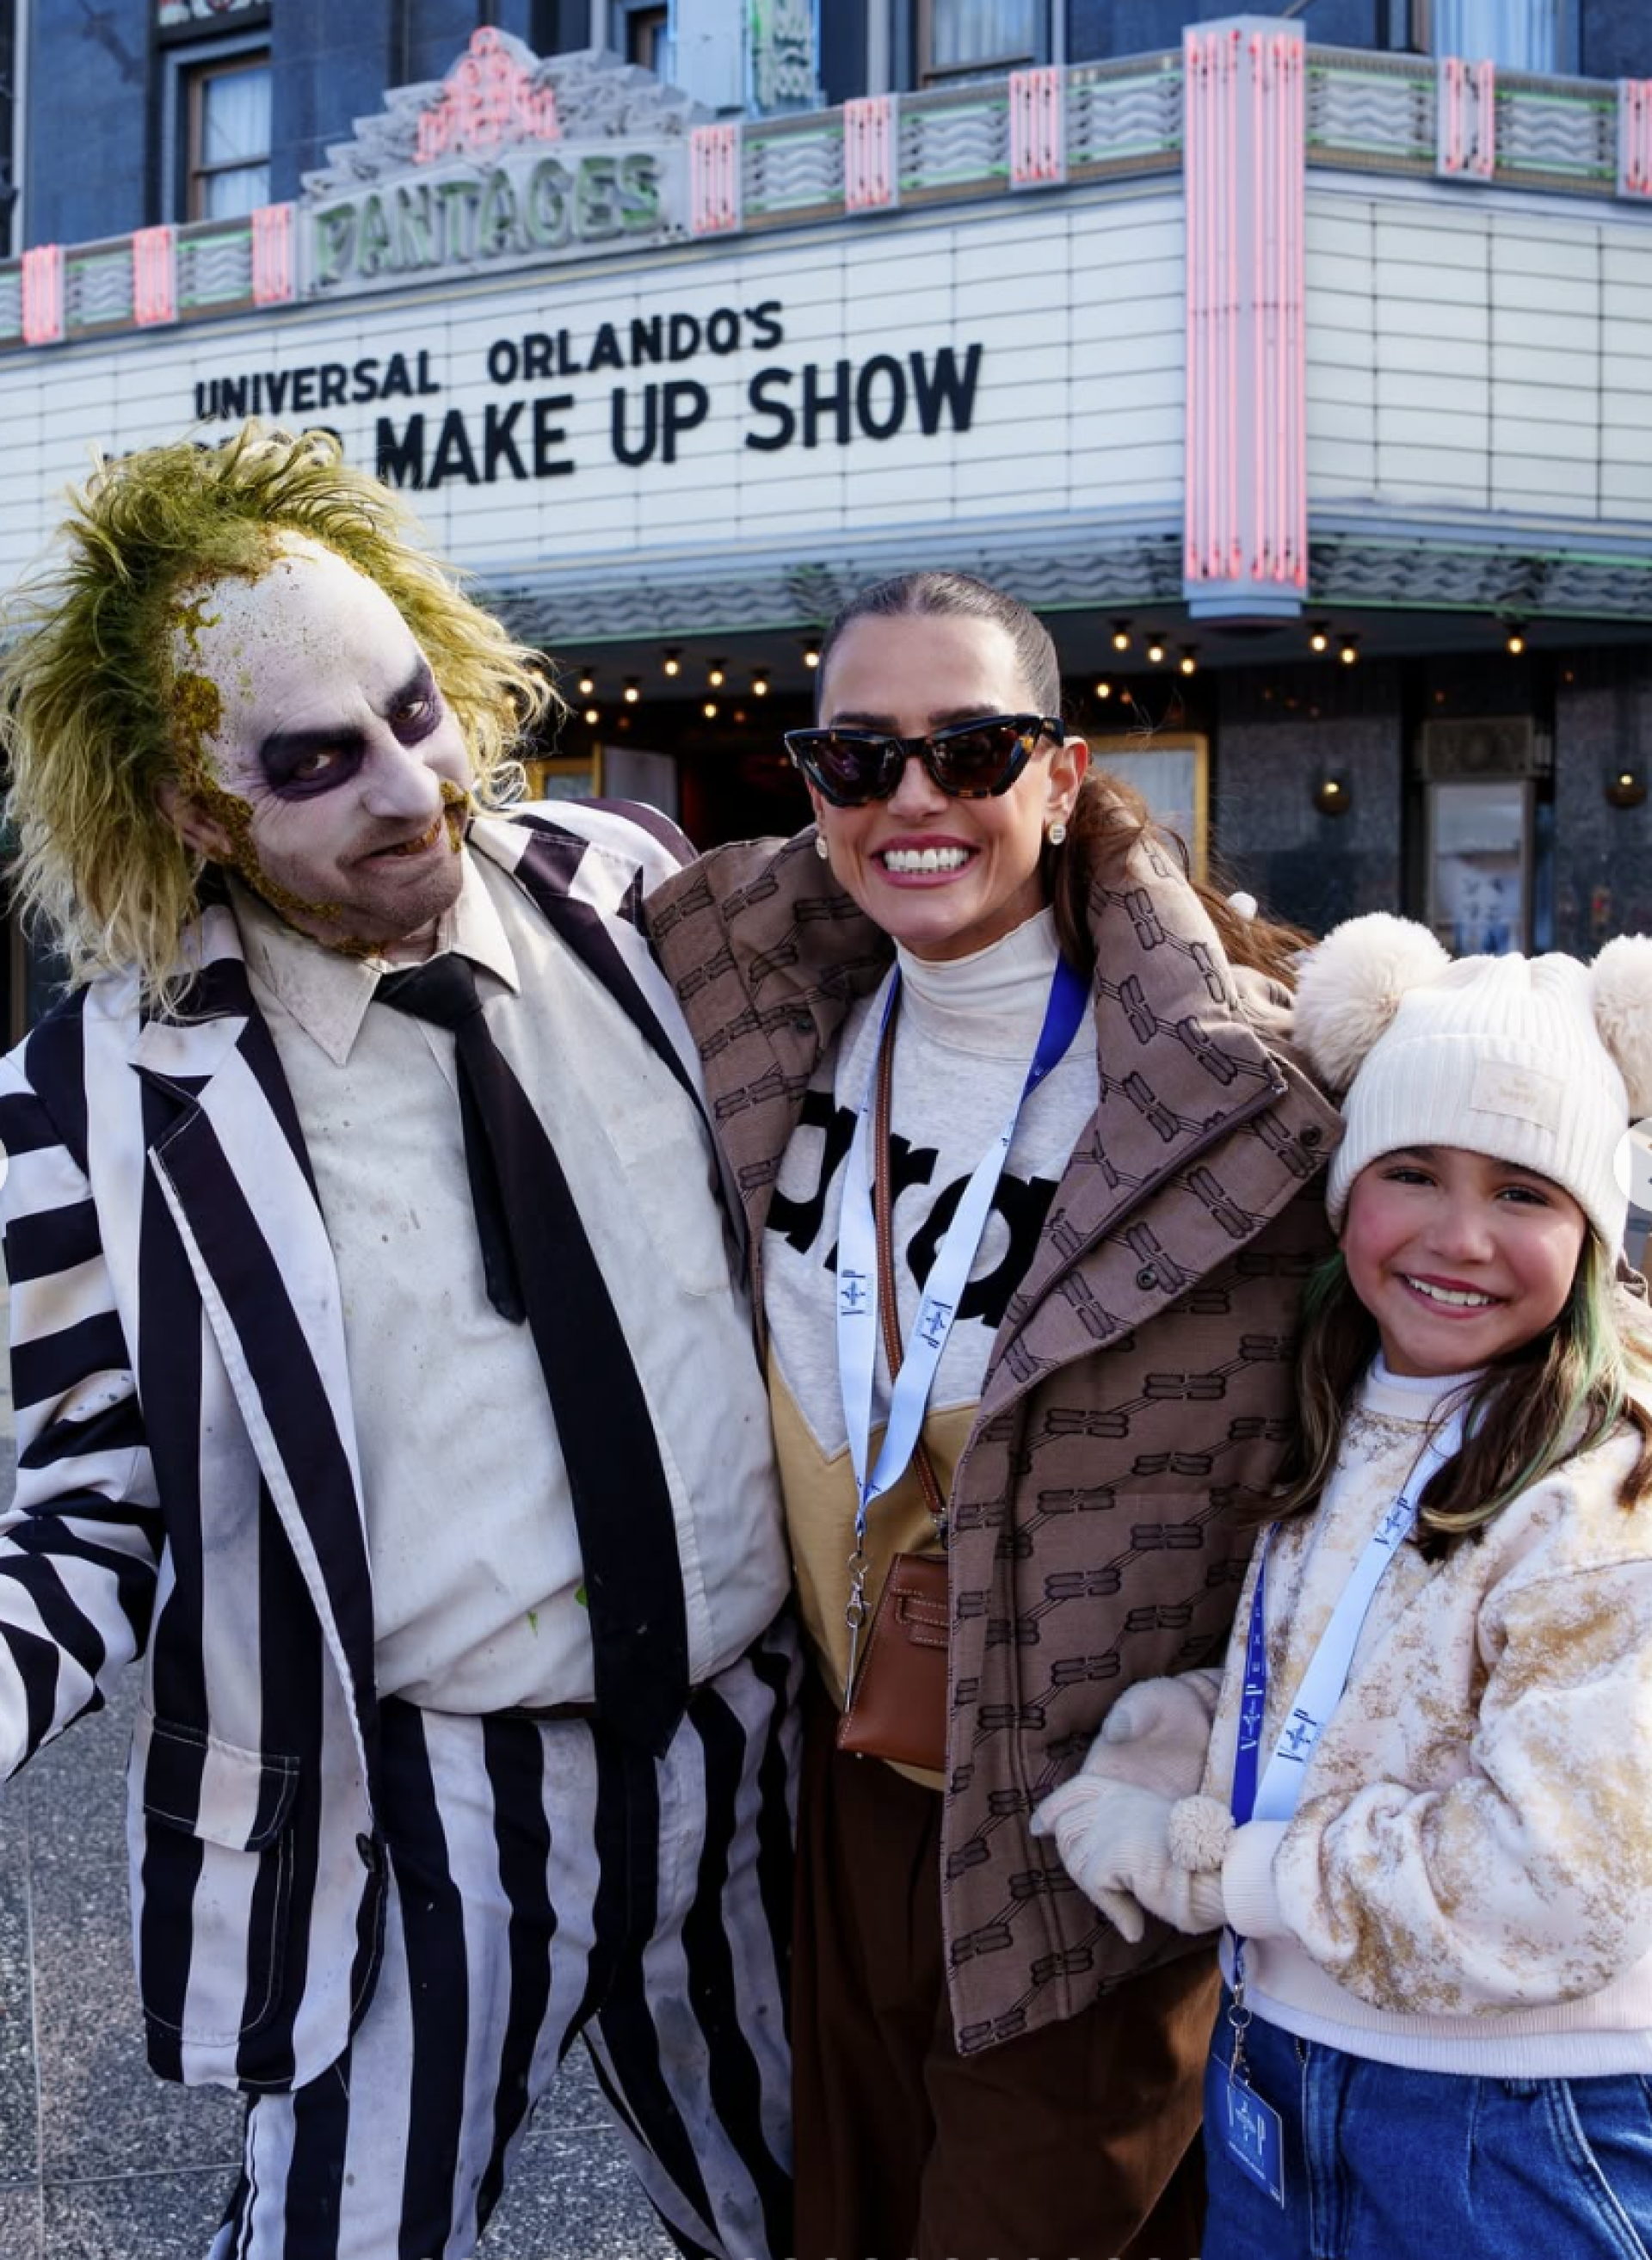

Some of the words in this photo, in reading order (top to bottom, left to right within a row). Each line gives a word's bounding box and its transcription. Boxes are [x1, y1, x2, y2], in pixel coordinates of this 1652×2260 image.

[315, 152, 666, 289] PANTAGES
[194, 350, 441, 422] UNIVERSAL
[486, 301, 783, 385] ORLANDO'S
[376, 394, 575, 492] MAKE
[610, 380, 709, 467] UP
[745, 343, 983, 452] SHOW
